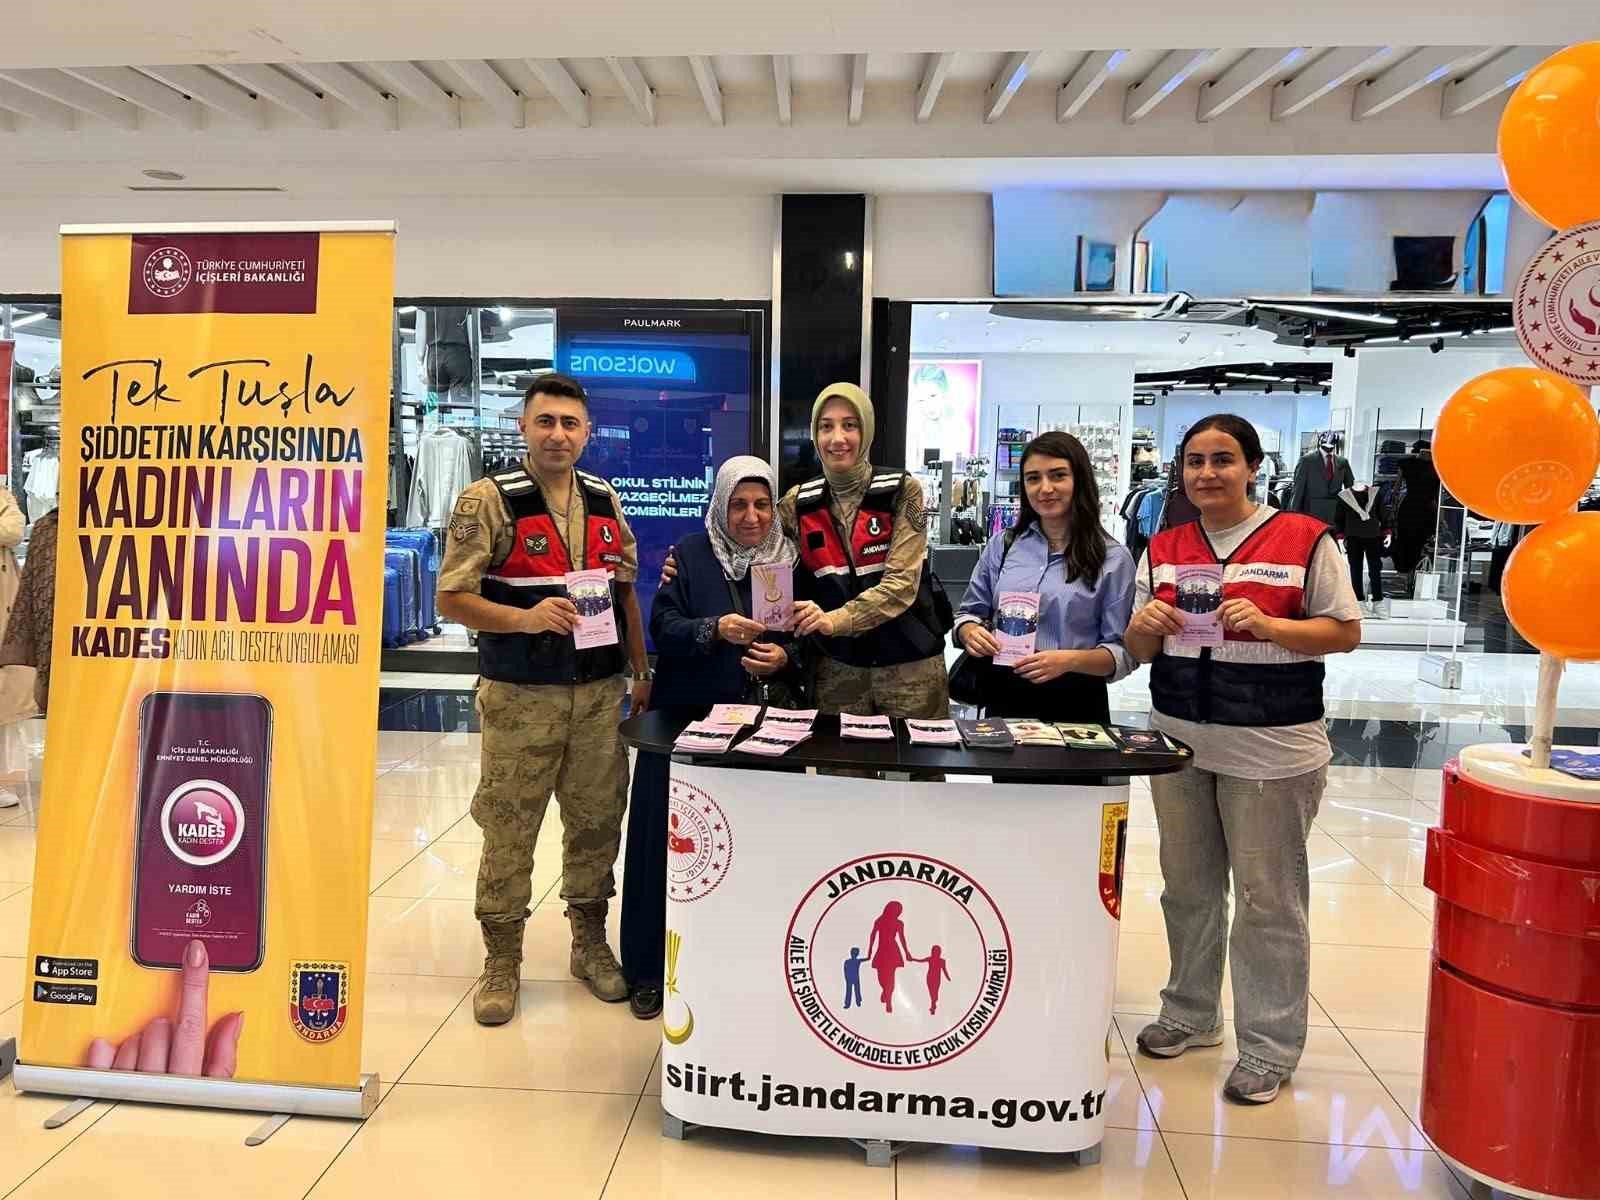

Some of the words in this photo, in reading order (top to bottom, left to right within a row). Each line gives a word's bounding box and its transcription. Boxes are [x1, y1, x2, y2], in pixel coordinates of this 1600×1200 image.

[195, 272, 241, 283] İÇİŞLERİ
[244, 271, 305, 282] BAKANLIĞI
[197, 259, 236, 270] TÜRKİYE
[239, 259, 305, 270] CUMHURİYETİ
[624, 319, 681, 328] PAULMARK
[83, 358, 181, 422] Tek
[188, 354, 355, 424] Tuşla
[80, 425, 193, 463] ŞİDDETİN
[199, 425, 363, 464] KARŞISINDA
[611, 477, 649, 488] OKUL
[652, 476, 709, 489] STİLİNİN
[78, 465, 363, 533] KADINLARIN
[79, 535, 357, 626] YANINDA
[1240, 567, 1289, 579] JANDARMA
[71, 626, 170, 660] KADES
[172, 628, 208, 660] KADIN
[211, 629, 235, 661] ACİL
[240, 631, 283, 663] DESTEK
[286, 632, 359, 665] UYGULAMASI
[178, 823, 226, 838] KADES
[168, 883, 207, 895] YARDIM
[209, 884, 232, 896] İSTE
[825, 859, 974, 905] JANDARMA
[790, 935, 808, 964] AİLE
[52, 966, 69, 977] App
[70, 967, 93, 976] Store
[789, 967, 812, 984] İÇİ
[984, 949, 1008, 1008] AMİRLİĞİ
[50, 991, 77, 1002] Google
[78, 993, 93, 1003] Play
[792, 985, 843, 1040] ŞİDDETLE
[960, 1005, 992, 1040] KISIM
[293, 1019, 342, 1039] JANDARMA
[837, 1034, 902, 1065] MÜCADELE
[905, 1049, 921, 1064] VE
[924, 1032, 965, 1065] ÇOCUK
[666, 1063, 1106, 1129] siirt.jandarma.gov.tr
